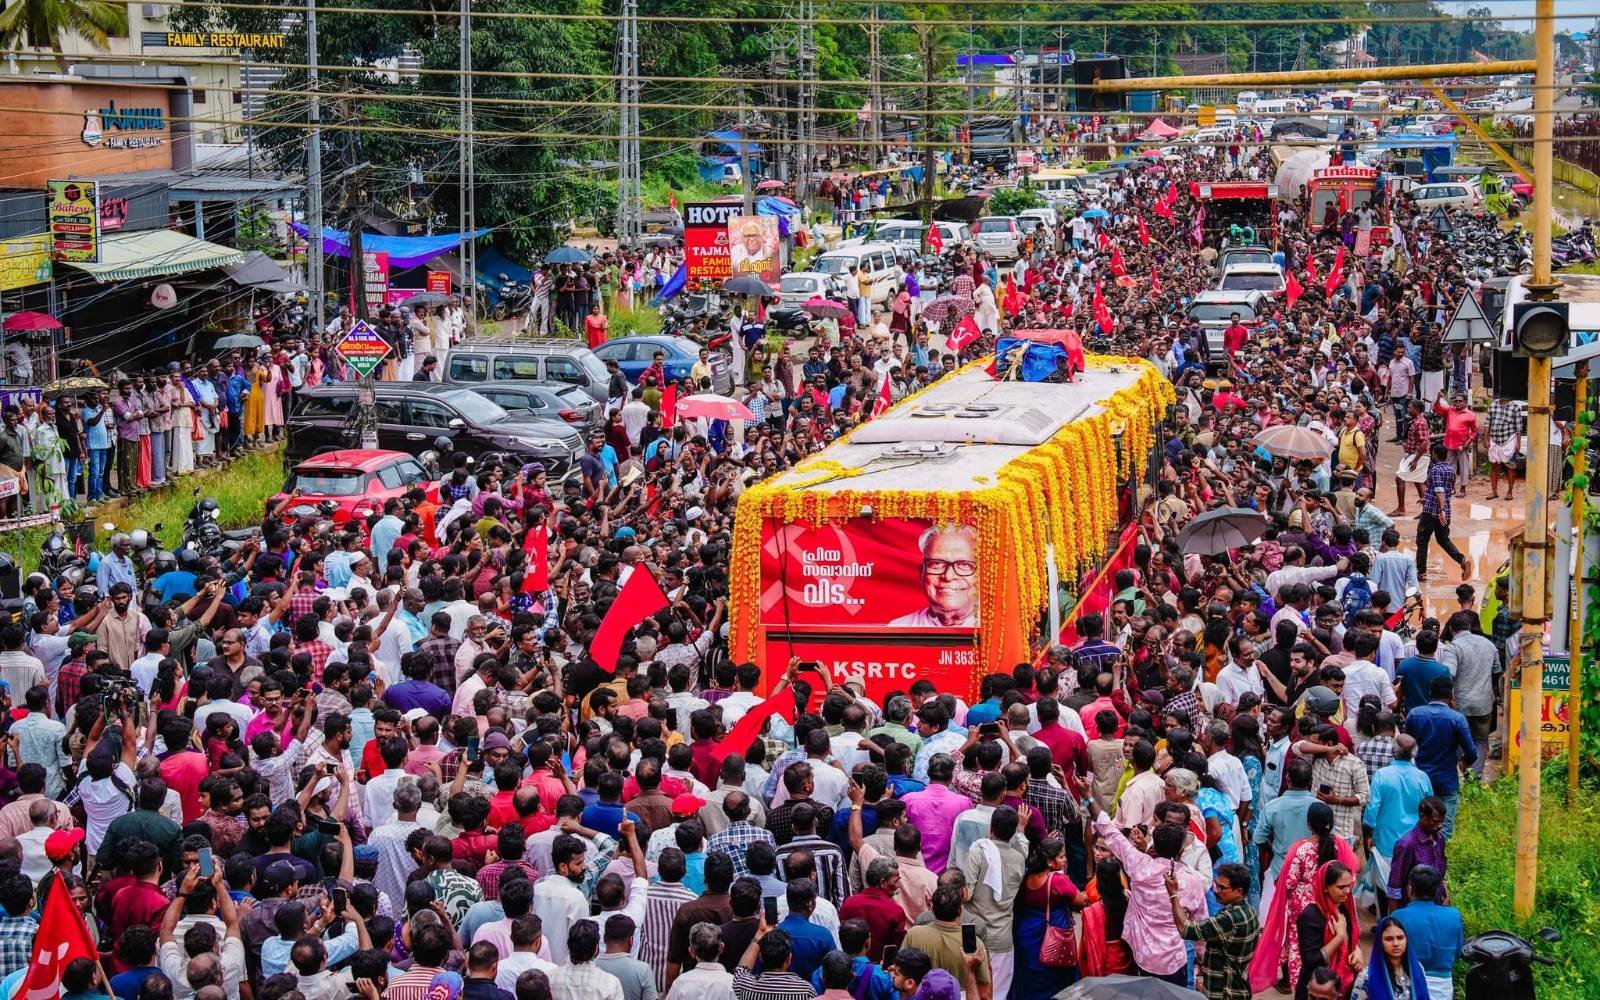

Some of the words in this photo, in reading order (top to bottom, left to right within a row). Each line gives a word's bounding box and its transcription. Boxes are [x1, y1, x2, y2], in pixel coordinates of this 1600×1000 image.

[167, 32, 205, 46] FAMILY
[210, 33, 285, 47] RESTAURANT
[1324, 166, 1377, 176] Indane
[54, 202, 90, 214] Bakery
[802, 546, 840, 564] പ്രിയ
[802, 561, 874, 577] സഖാവിന്
[803, 578, 865, 605] വിട...
[938, 651, 952, 665] JN
[833, 661, 916, 679] KSRTC
